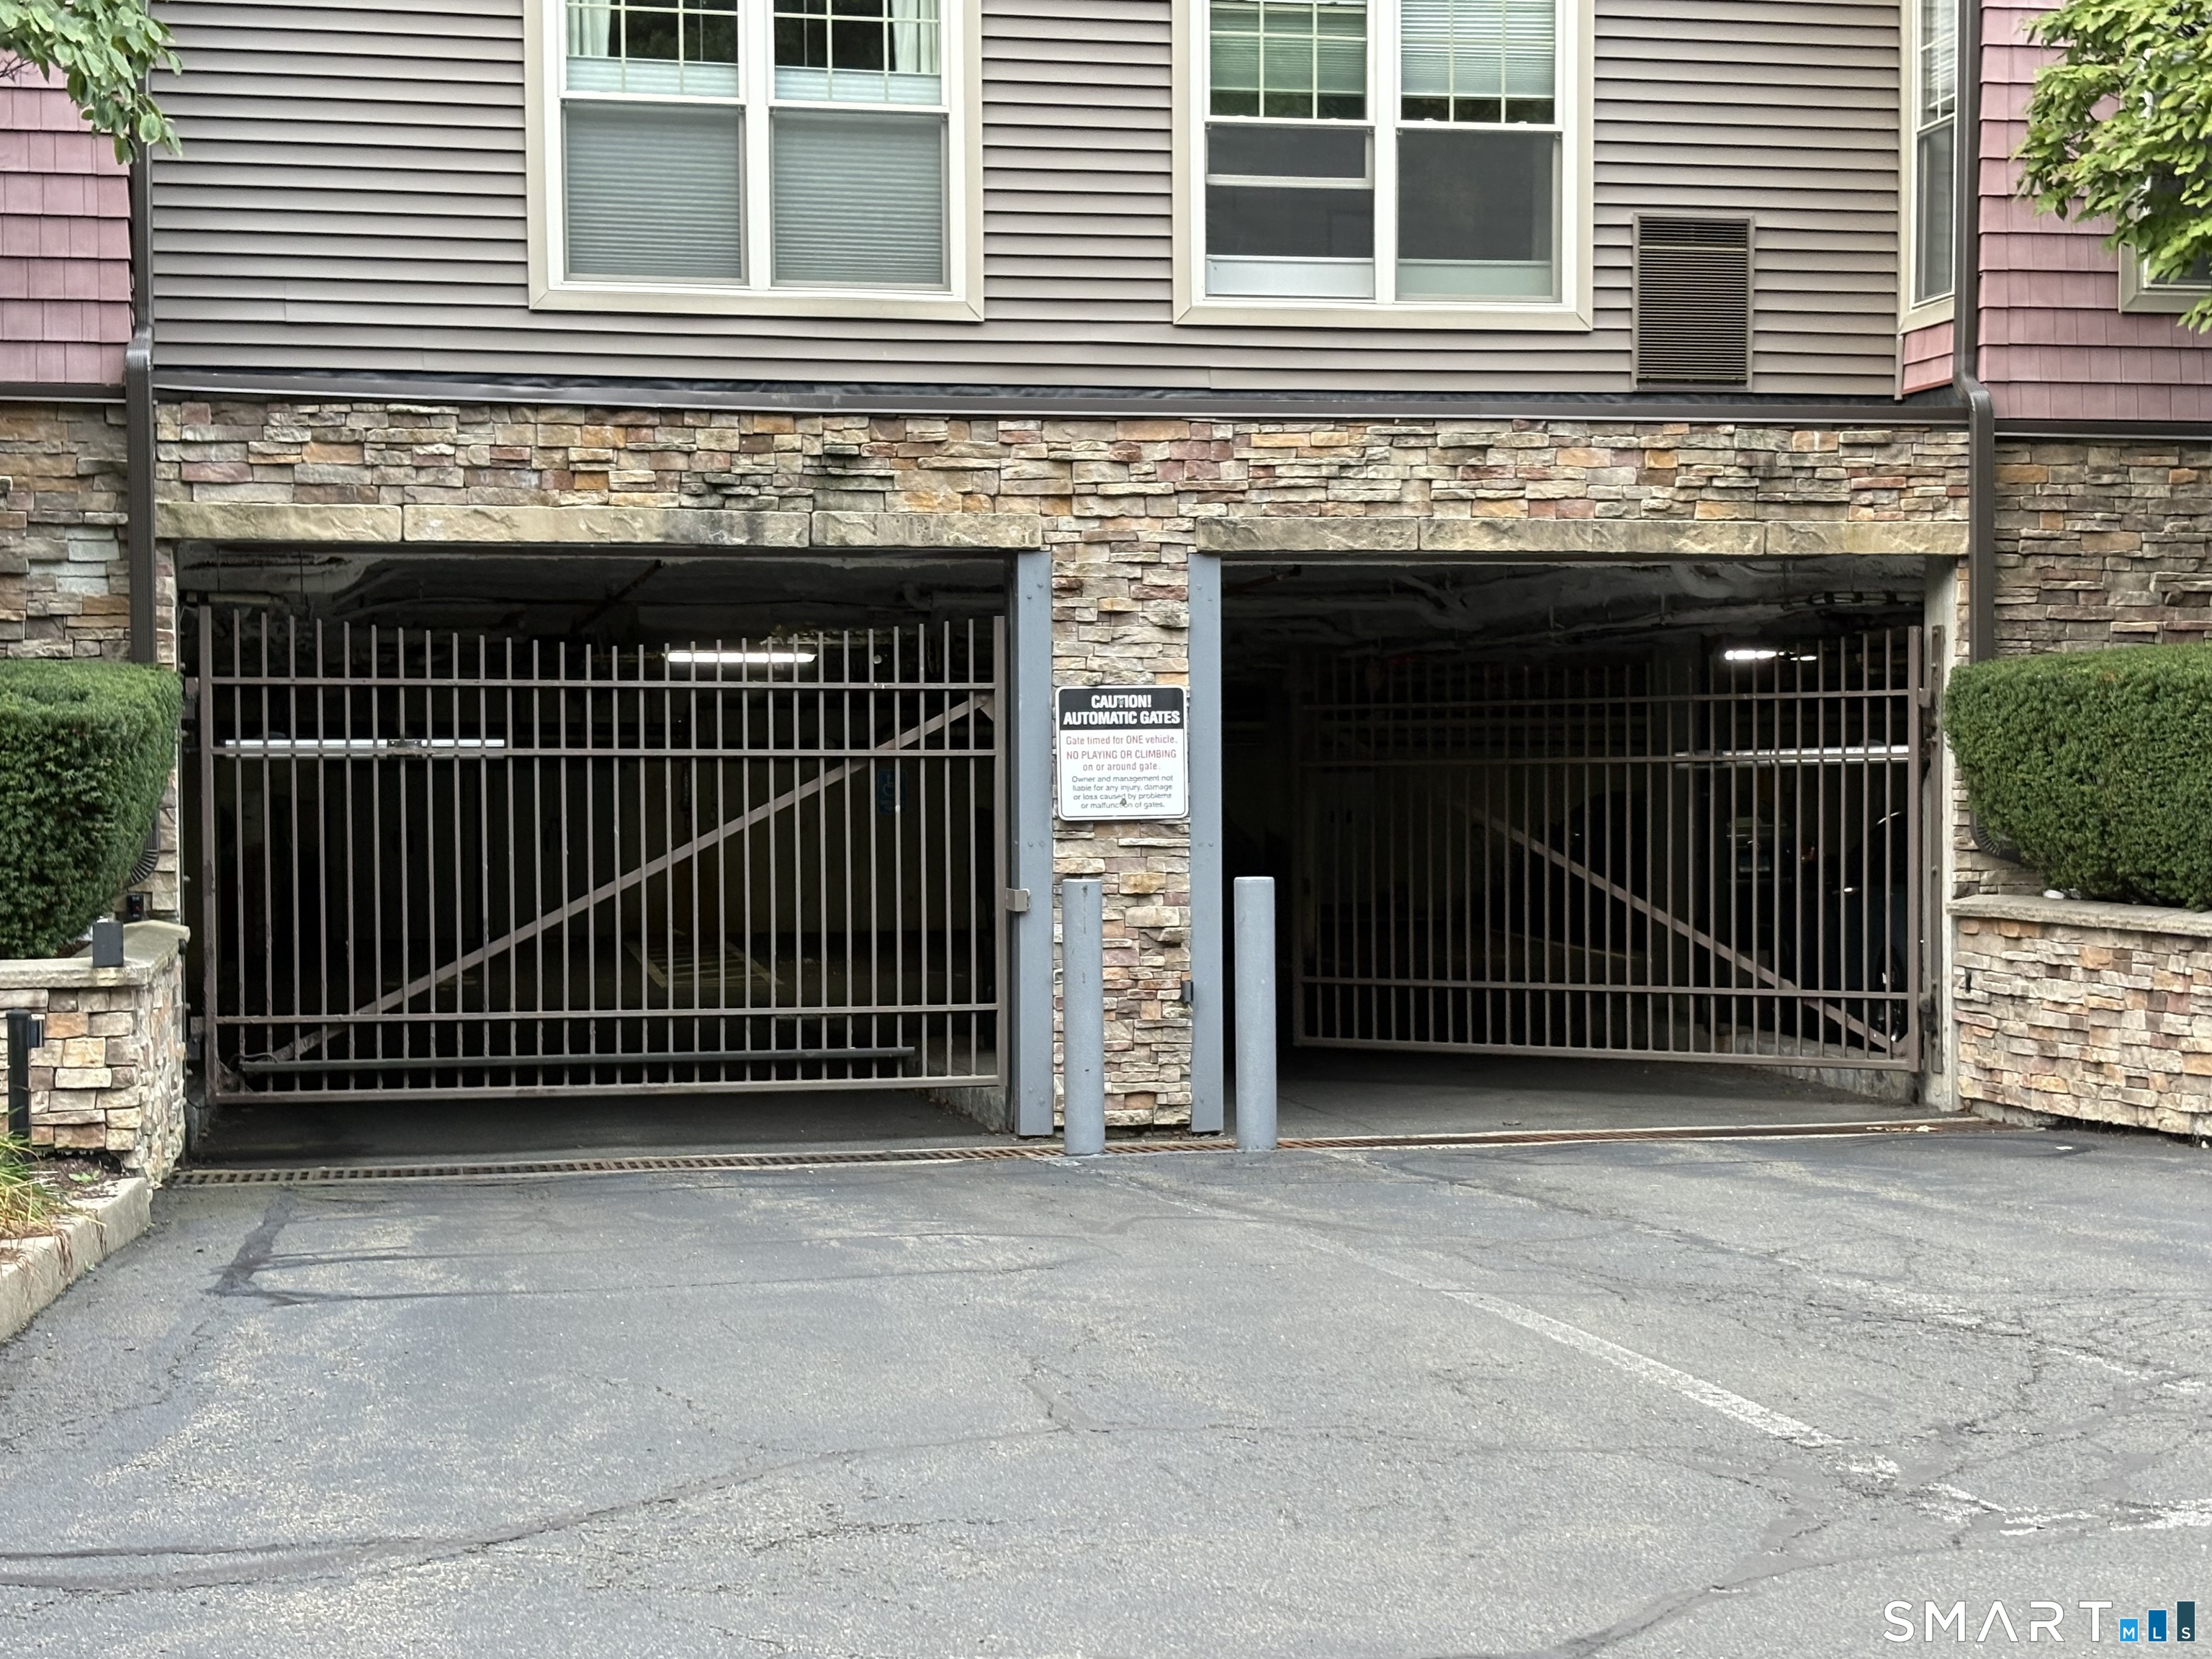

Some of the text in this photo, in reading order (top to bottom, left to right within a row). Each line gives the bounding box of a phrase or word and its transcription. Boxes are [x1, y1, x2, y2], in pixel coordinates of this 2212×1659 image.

[1091, 695, 1151, 709] CAUTION!
[1063, 711, 1180, 725] AUTOMATIC GATES
[1087, 736, 1110, 745] timed
[1126, 735, 1143, 744] ONE
[1066, 750, 1177, 760] NO PLAYING OR CLIMBING
